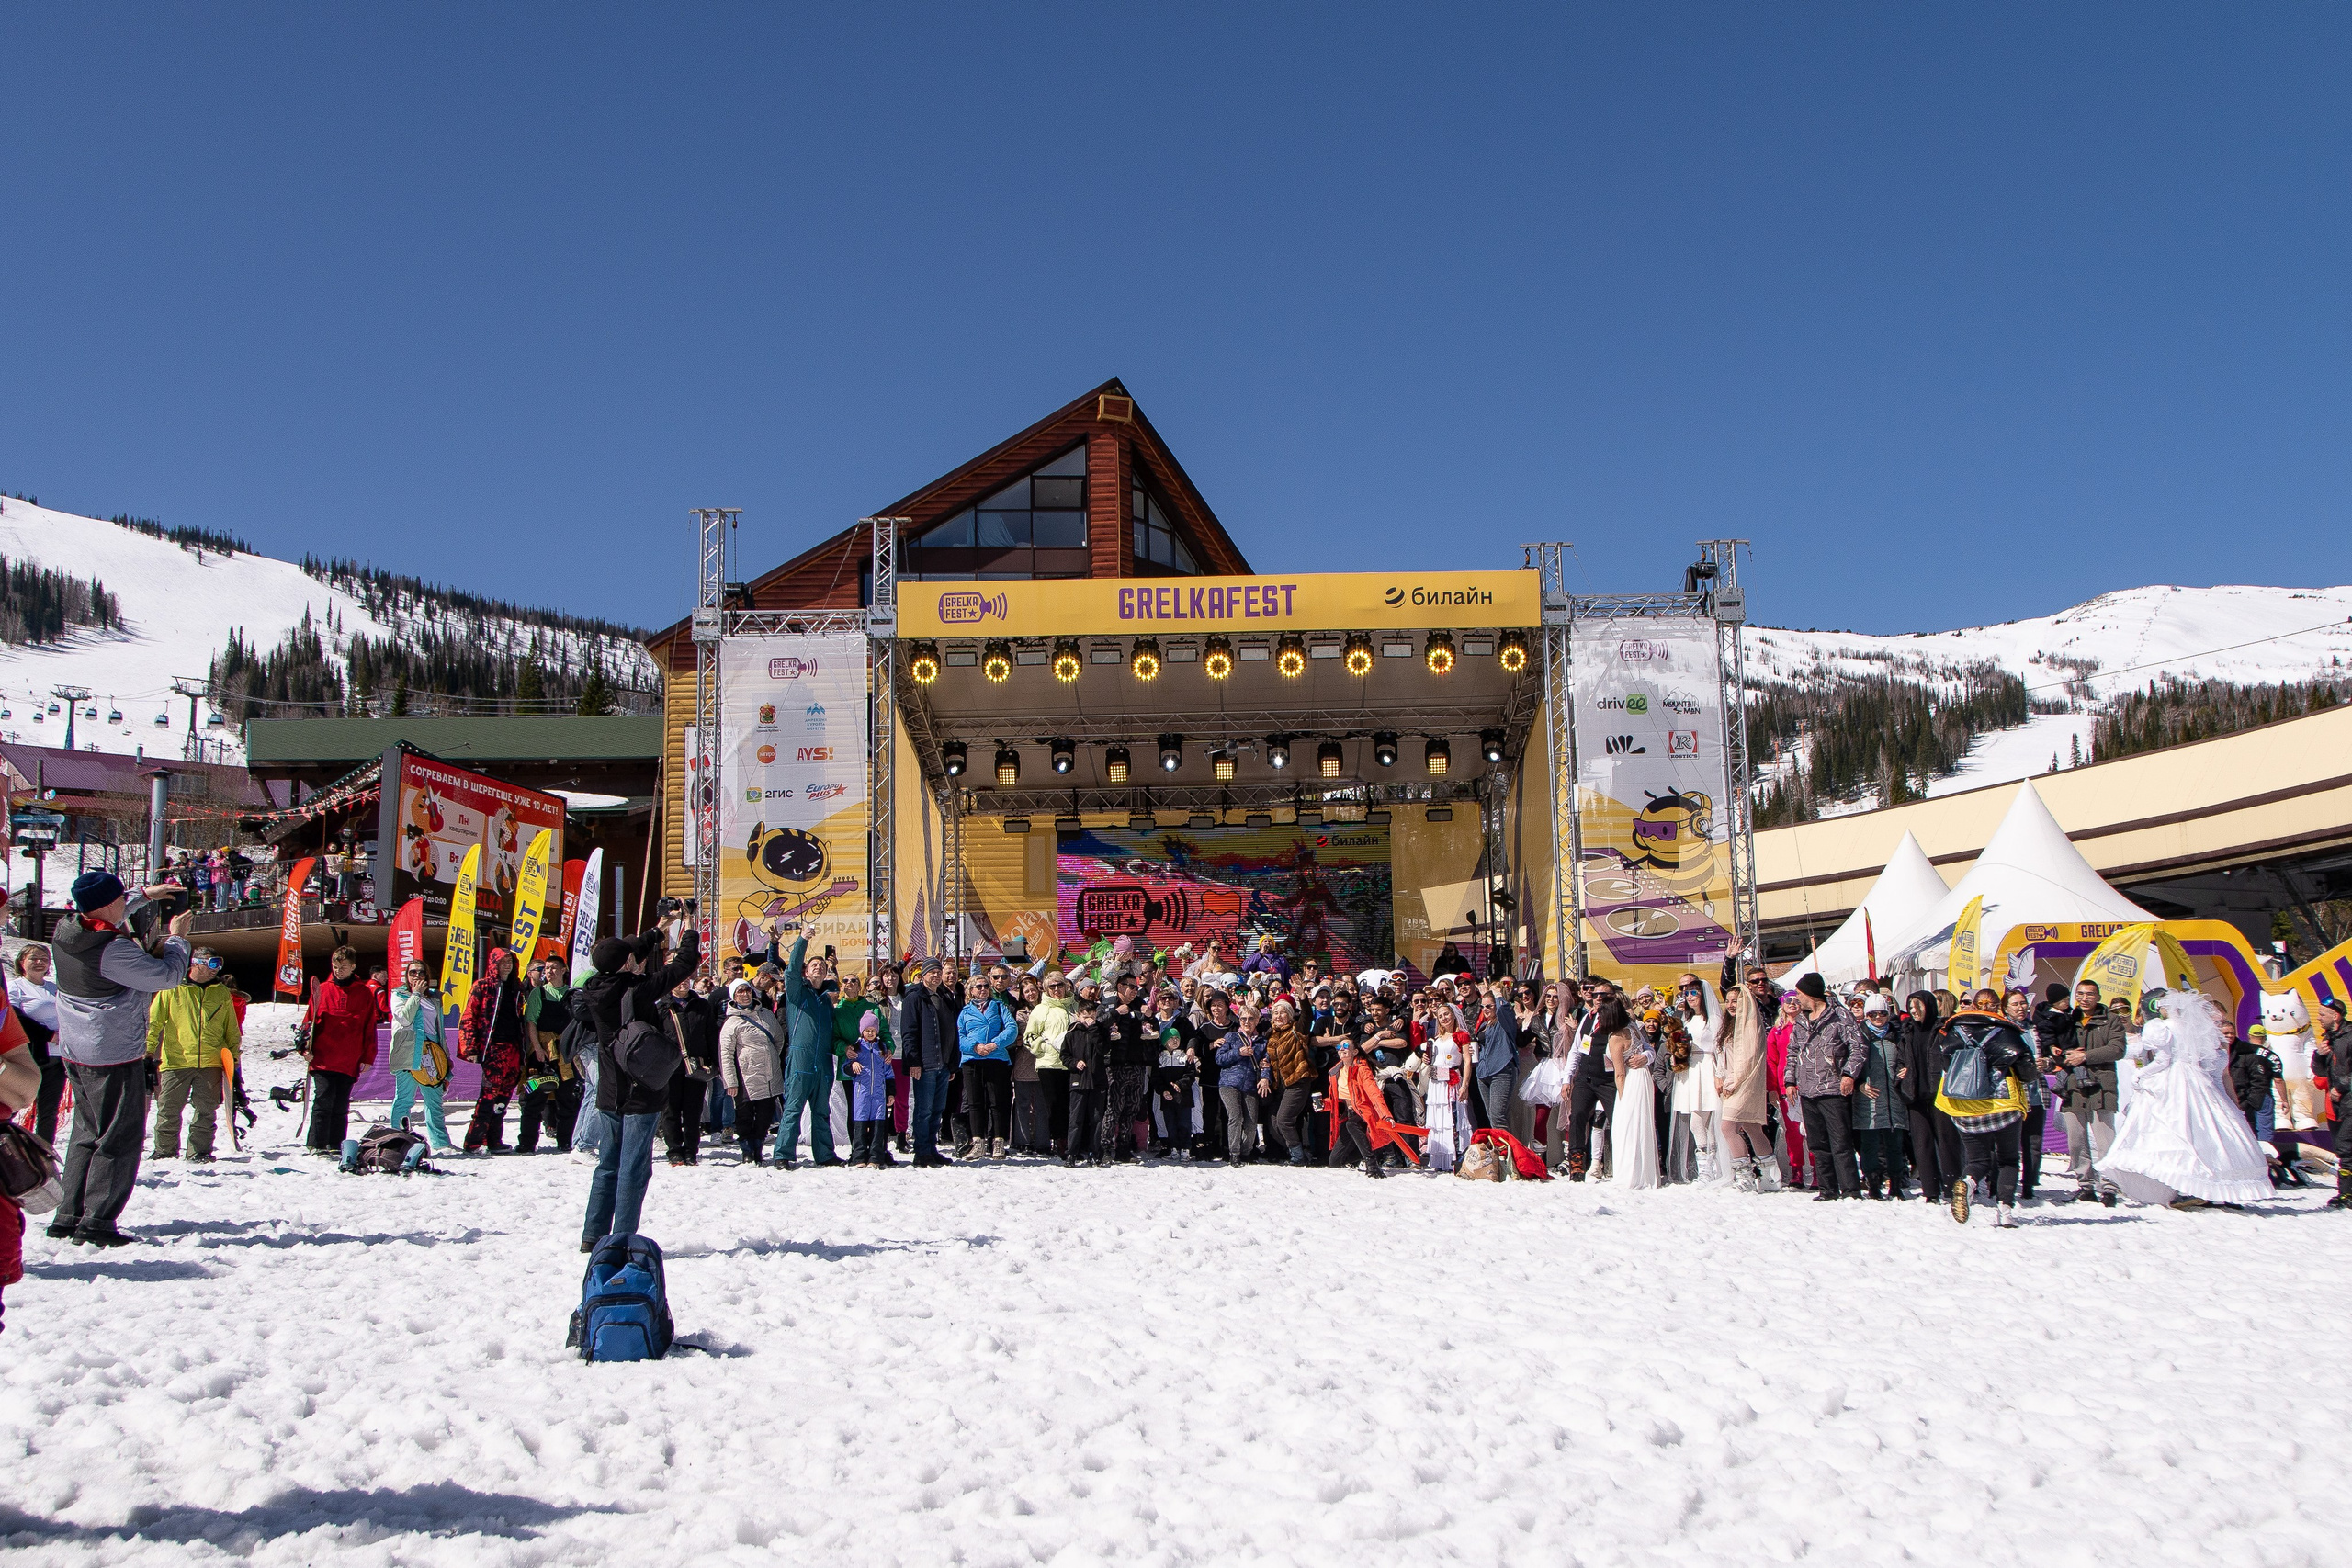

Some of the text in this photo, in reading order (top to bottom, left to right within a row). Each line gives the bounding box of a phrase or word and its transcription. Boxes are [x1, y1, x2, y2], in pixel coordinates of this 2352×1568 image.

[945, 596, 978, 607] GRELKA
[1118, 584, 1297, 620] GRELKAFEST
[1411, 586, 1493, 606] билайн
[945, 608, 967, 619] FEST
[1623, 642, 1648, 650] GRELKA
[1624, 650, 1641, 659] FEST
[773, 660, 797, 669] GRELKA
[1596, 697, 1648, 711] drivee
[1662, 699, 1700, 708] MOUNTAIN
[797, 746, 834, 761] AYS!
[410, 764, 559, 815] СОГРЕВАЕМ В ШЕРЕГЕШЕ УЖЕ 10 ЛЕТ!
[764, 790, 794, 798] 2ГИС
[1331, 834, 1379, 846] билайн
[476, 891, 503, 911] ELKA
[1088, 894, 1140, 911] GRELKA
[509, 899, 537, 955] EST
[1088, 912, 1124, 930] FEST
